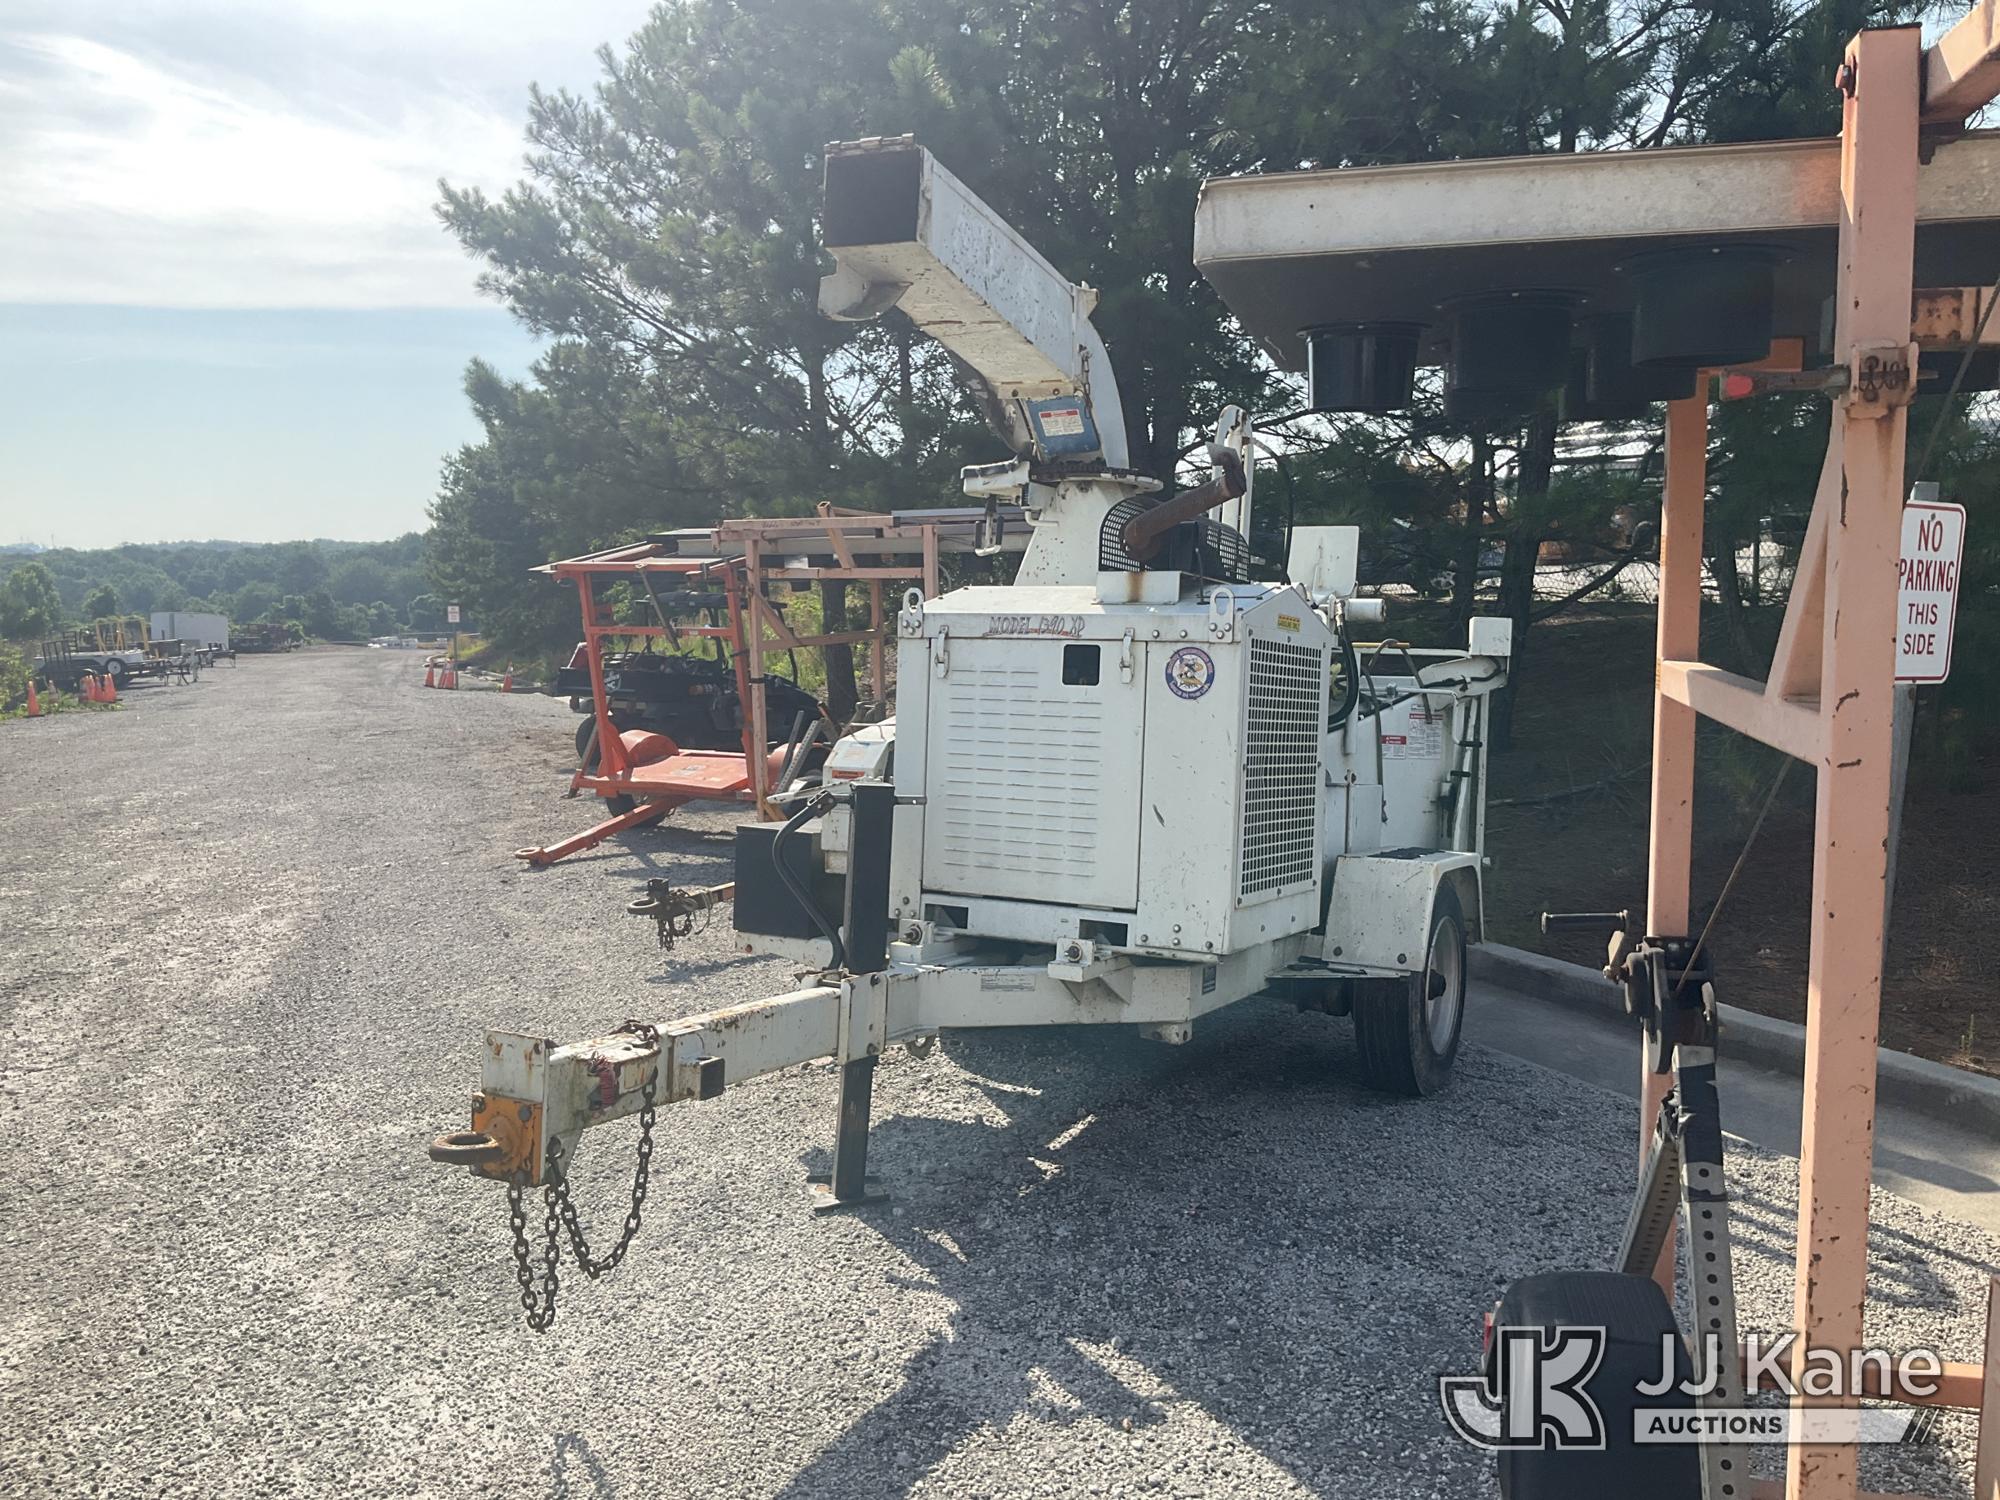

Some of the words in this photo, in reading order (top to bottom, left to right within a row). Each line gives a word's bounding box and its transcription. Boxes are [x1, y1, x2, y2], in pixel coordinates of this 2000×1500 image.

[1918, 519, 1943, 552] NO
[1900, 558, 1955, 592] PARKING
[1908, 603, 1938, 625] THIS
[989, 616, 1031, 634] MODEL
[1069, 615, 1086, 637] XP
[1903, 633, 1936, 655] SIDE
